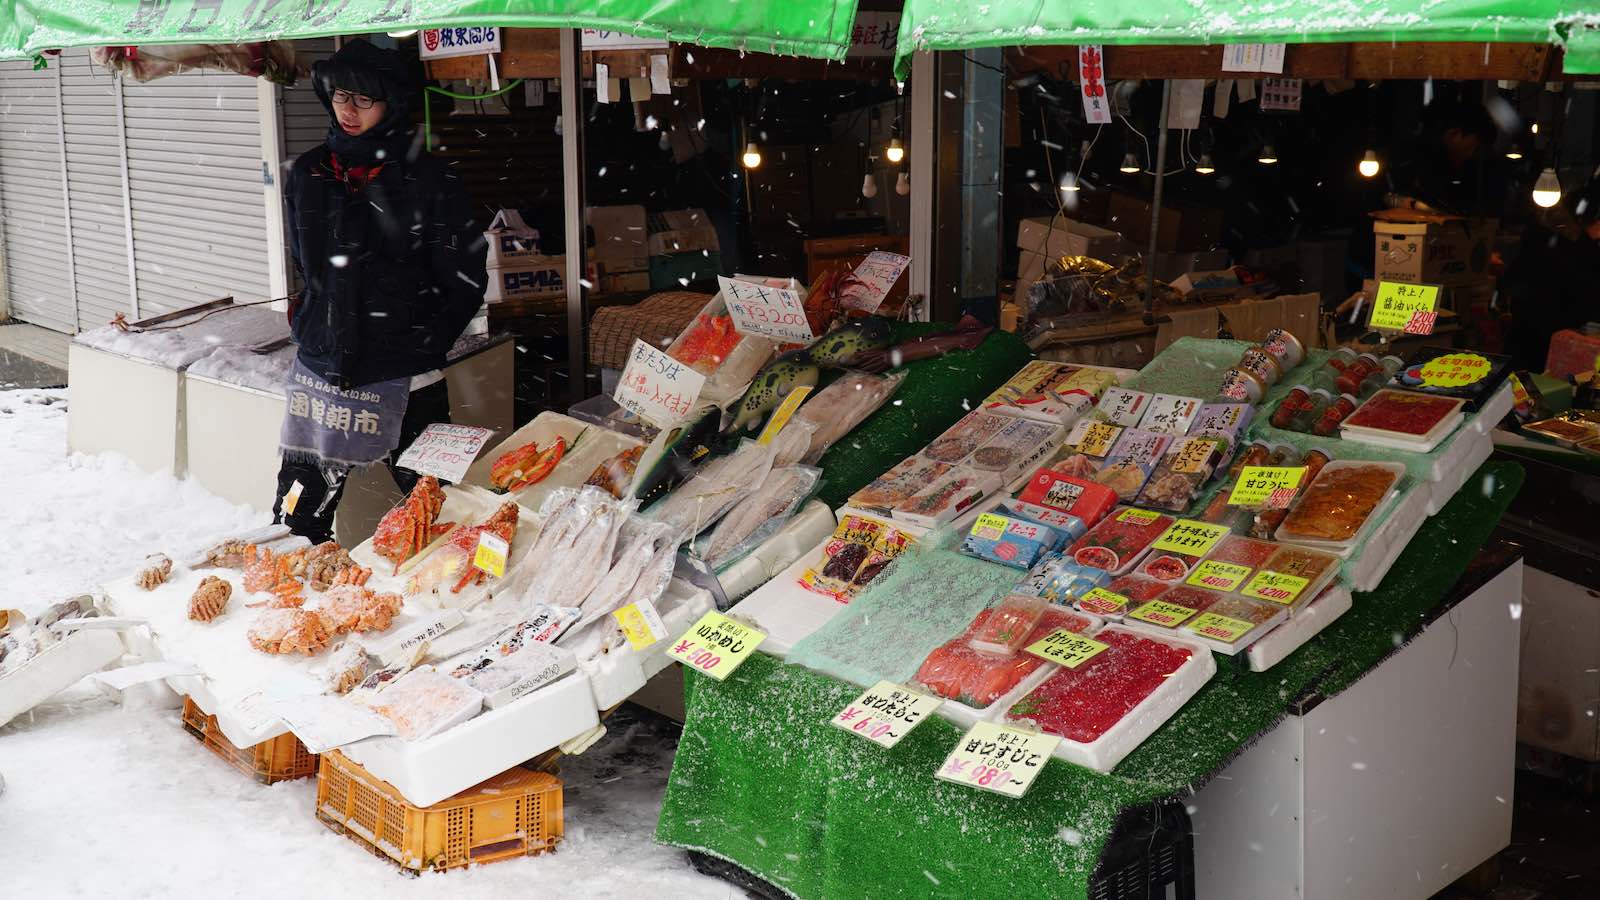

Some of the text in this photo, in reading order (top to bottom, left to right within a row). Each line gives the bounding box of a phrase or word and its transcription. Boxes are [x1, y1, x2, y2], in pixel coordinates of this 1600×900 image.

[1383, 297, 1428, 312] 醤油いくら
[697, 624, 745, 653] いかめし
[1045, 630, 1095, 655] 計り売り
[861, 694, 920, 724] 甘口たらこ
[964, 738, 1044, 768] 甘口すじこ
